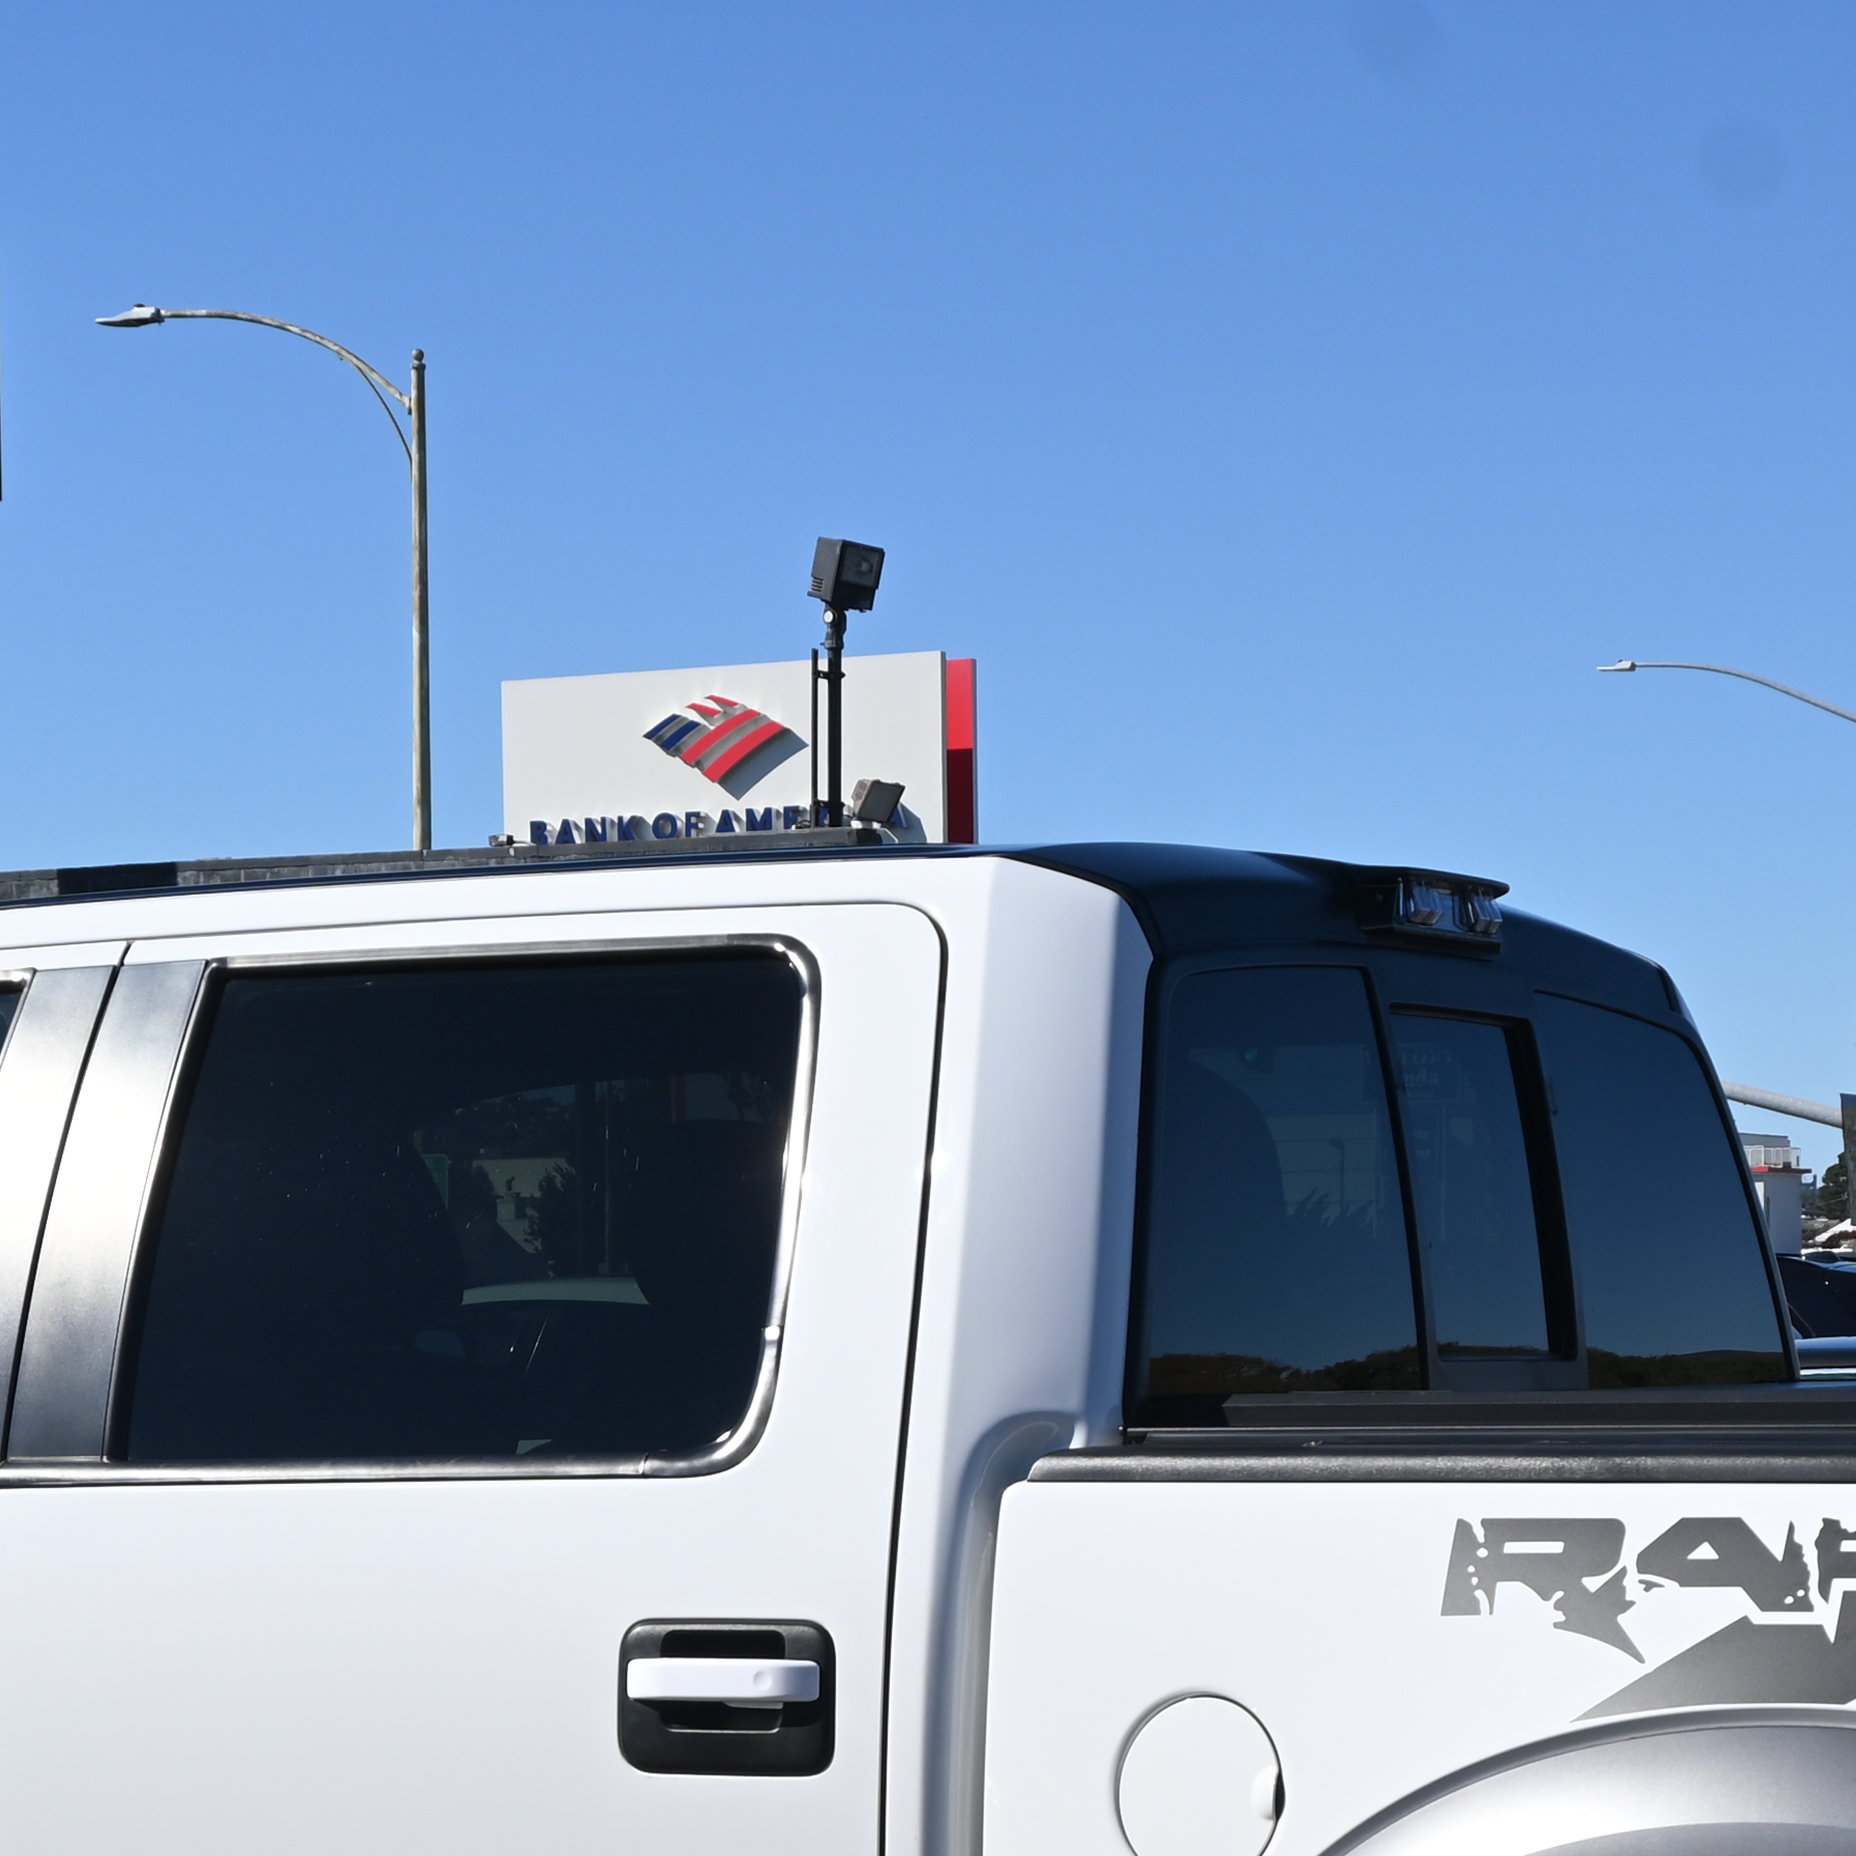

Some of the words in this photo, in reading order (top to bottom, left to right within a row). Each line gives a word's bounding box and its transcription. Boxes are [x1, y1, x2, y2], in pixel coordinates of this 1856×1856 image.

[529, 815, 638, 845] BANK
[652, 811, 704, 839] OF
[715, 805, 907, 833] AMEA
